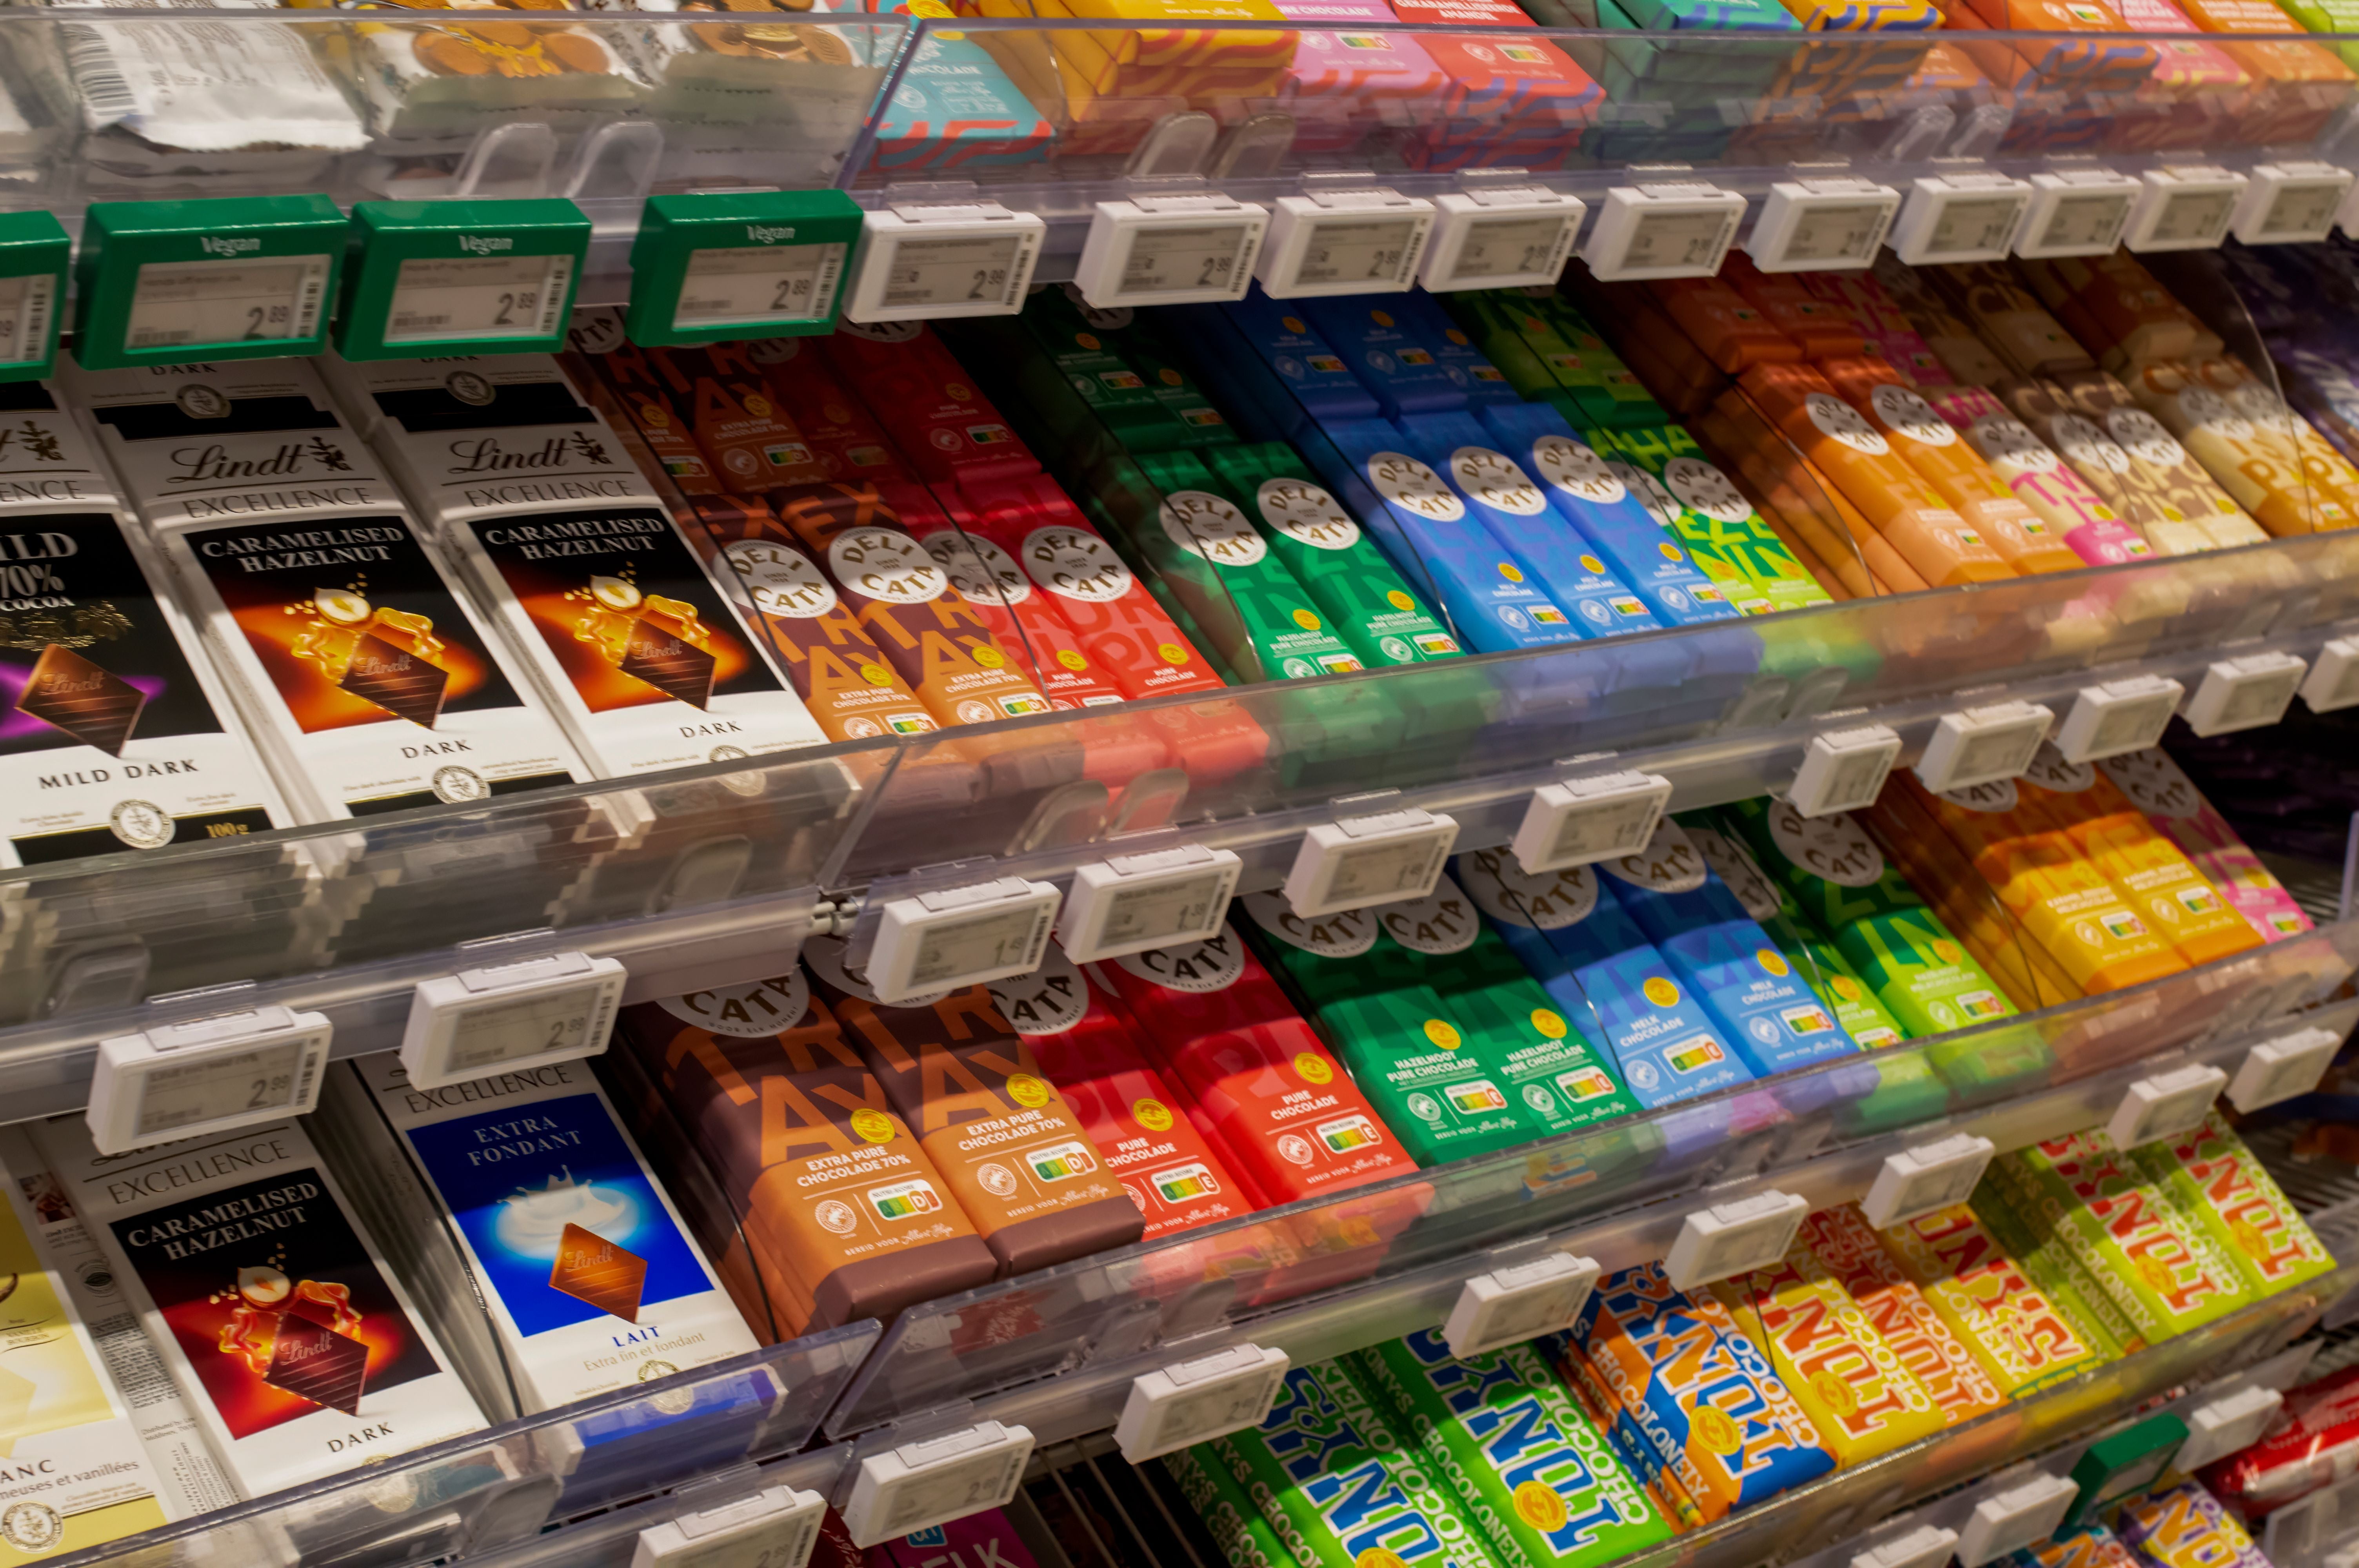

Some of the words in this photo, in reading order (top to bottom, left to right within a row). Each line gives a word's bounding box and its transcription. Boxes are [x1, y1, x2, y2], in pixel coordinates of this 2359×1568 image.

[200, 236, 261, 256] Vegan
[459, 235, 513, 255] Vegan
[747, 225, 796, 243] Vegan
[166, 444, 309, 483] Lindt
[448, 437, 575, 475] Lindt
[183, 487, 376, 519] EXCELLENCE
[464, 479, 635, 508] EXCELLENCE
[1269, 484, 1328, 510] DELI
[201, 527, 405, 558] CARAMELISED
[485, 517, 665, 545] CARAMELISED
[1287, 515, 1348, 543] CATA
[236, 546, 393, 573] HAZELNUT
[518, 535, 658, 561] HAZELNUT
[843, 535, 914, 564] DELI
[1034, 534, 1099, 563] DELI
[860, 566, 934, 595] CATA
[1053, 564, 1120, 593] CATA
[0, 595, 76, 612] COCOA
[751, 580, 825, 609] CATA
[630, 639, 683, 660] Lindt
[353, 654, 412, 677] Lindt
[951, 671, 981, 683] EXTRA
[981, 668, 1008, 678] PURE
[1052, 672, 1076, 681] PURE
[1144, 671, 1198, 686] CHOCOLADE
[1153, 667, 1178, 676] PURE
[38, 670, 107, 695] Lindt
[838, 689, 870, 700] EXTRA
[871, 688, 895, 696] PURE
[945, 677, 1001, 693] CHOCOLADE
[832, 694, 886, 708] CHOCOLADE
[679, 720, 743, 738] DARK
[400, 739, 473, 759] DARK
[38, 769, 111, 790] MILD
[123, 759, 199, 780] DARK
[1385, 900, 1462, 943] CATA
[1141, 934, 1228, 979] CATA
[682, 975, 792, 1023] CATA
[1619, 1016, 1685, 1048] CHOCOLADE
[1630, 1014, 1661, 1032] MELK
[1394, 1050, 1458, 1071] HAZELNOOT
[1500, 1058, 1530, 1076] PURE
[1528, 1044, 1586, 1068] CHOCOLADE
[1505, 1040, 1565, 1063] HAZELNOOT
[1385, 1065, 1416, 1083] PURE
[1414, 1057, 1479, 1078] CHOCOLADE
[404, 1065, 572, 1113] EXCELLENCE
[1281, 1089, 1313, 1106] PURE
[1270, 1094, 1339, 1120] CHOCOLADE
[473, 1116, 559, 1143] EXTRA
[958, 1125, 1038, 1152] CHOCOLADE
[1039, 1116, 1066, 1132] 70%
[966, 1118, 1009, 1137] EXTRA
[1009, 1110, 1043, 1127] PURE
[467, 1130, 583, 1166] FONDANT
[806, 1153, 855, 1172] EXTRA
[854, 1145, 889, 1161] PURE
[1105, 1142, 1178, 1168] CHOCOLADE
[1116, 1137, 1150, 1153] PURE
[107, 1140, 291, 1204] EXCELLENCE
[796, 1159, 883, 1187] CHOCOLADE
[883, 1154, 912, 1169] 70%
[127, 1182, 319, 1249] CARAMELISED
[162, 1206, 309, 1260] HAZELNUT
[563, 1245, 614, 1272] Lindt
[279, 1331, 333, 1366] Lindt
[612, 1325, 662, 1347] LAIT
[583, 1353, 619, 1372] Extra
[619, 1346, 639, 1363] fin
[640, 1343, 656, 1356] et
[655, 1332, 706, 1354] fondant
[326, 1422, 395, 1452] DARK
[1502, 1346, 1650, 1524] CHOCOLON
[56, 1475, 73, 1486] et
[73, 1461, 140, 1481] vanillées
